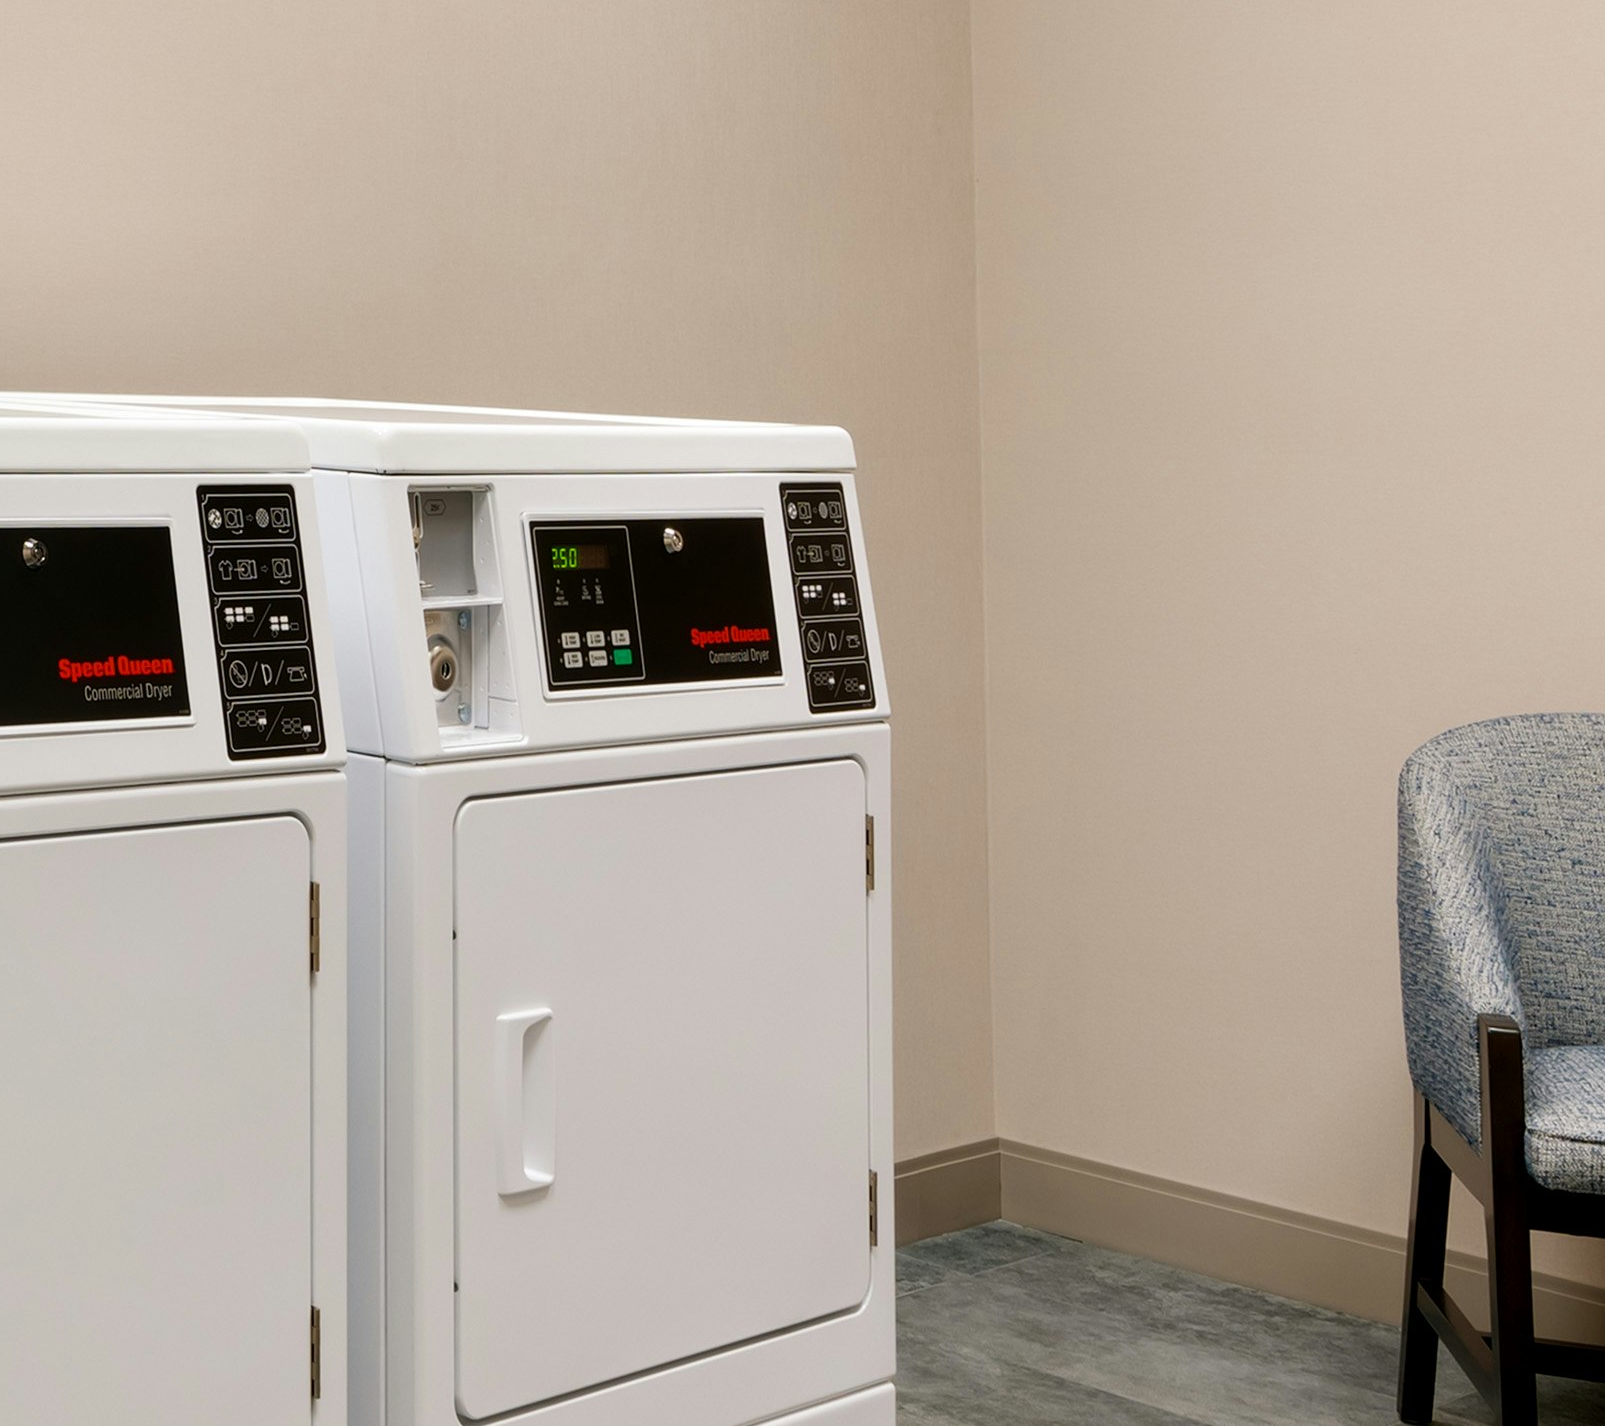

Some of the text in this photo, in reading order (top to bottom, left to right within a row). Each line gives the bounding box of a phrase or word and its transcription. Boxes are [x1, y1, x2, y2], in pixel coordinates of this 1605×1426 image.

[691, 625, 770, 648] Speed Queen
[709, 648, 769, 664] Commercial Dryer
[58, 655, 173, 683] Speed Queen
[84, 682, 173, 702] Commercial Dryer
